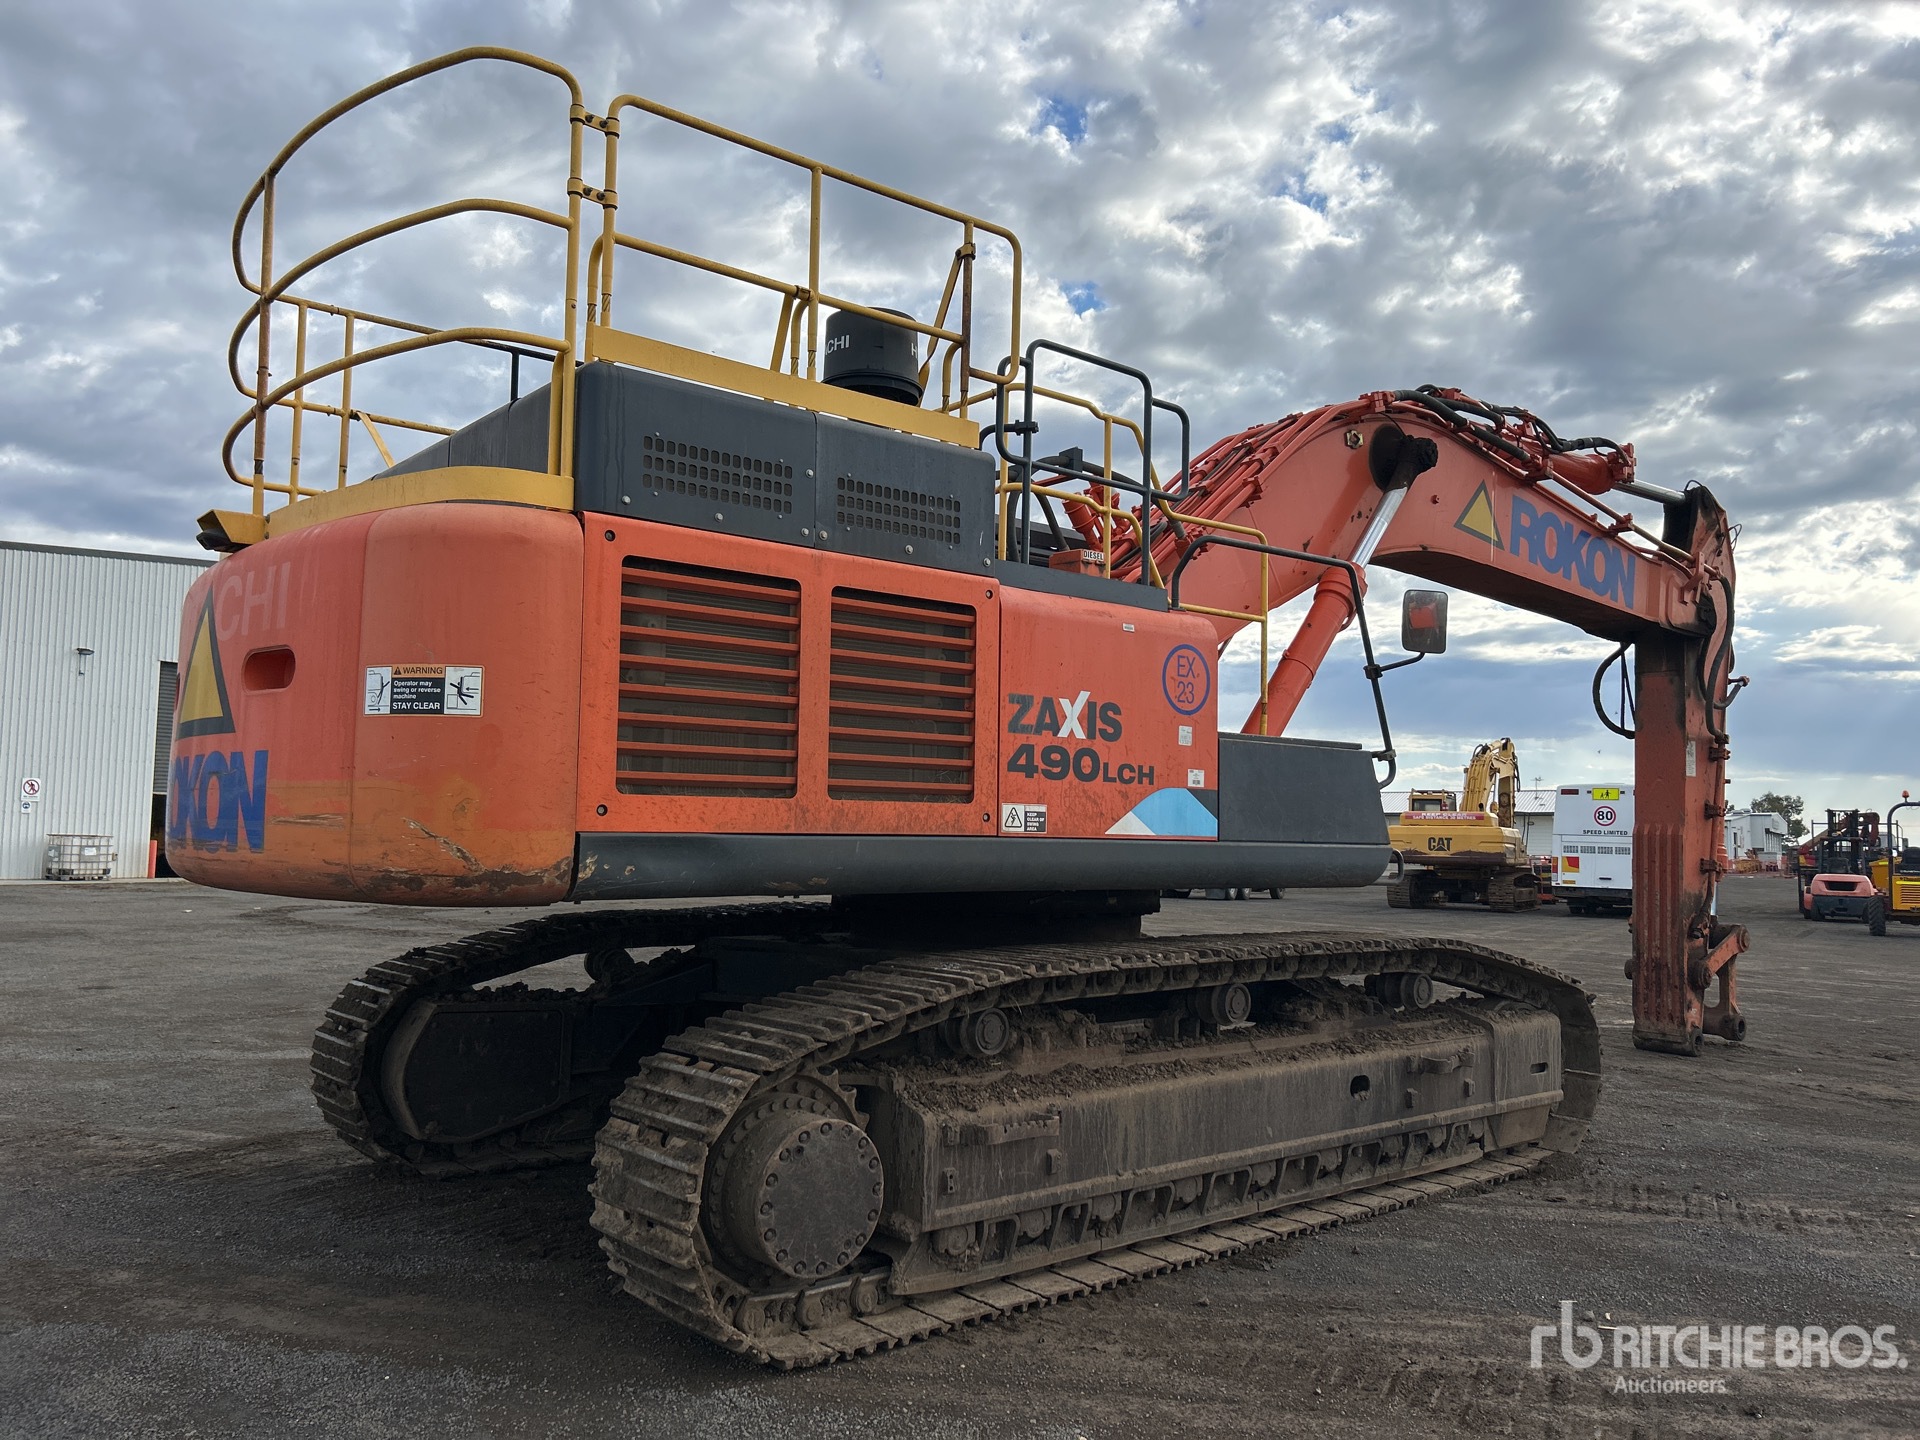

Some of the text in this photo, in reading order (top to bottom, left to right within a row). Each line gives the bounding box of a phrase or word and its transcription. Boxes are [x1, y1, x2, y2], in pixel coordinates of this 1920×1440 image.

[825, 334, 849, 355] CHI
[1083, 551, 1103, 560] DIESEL
[1510, 495, 1636, 609] ROKON
[215, 561, 291, 641] CHI
[403, 667, 443, 675] WARNING
[1177, 655, 1196, 679] EX
[1177, 681, 1195, 704] 23
[1007, 690, 1122, 742] ZAXIS
[1597, 810, 1613, 820] 80
[1428, 837, 1452, 852] CAT
